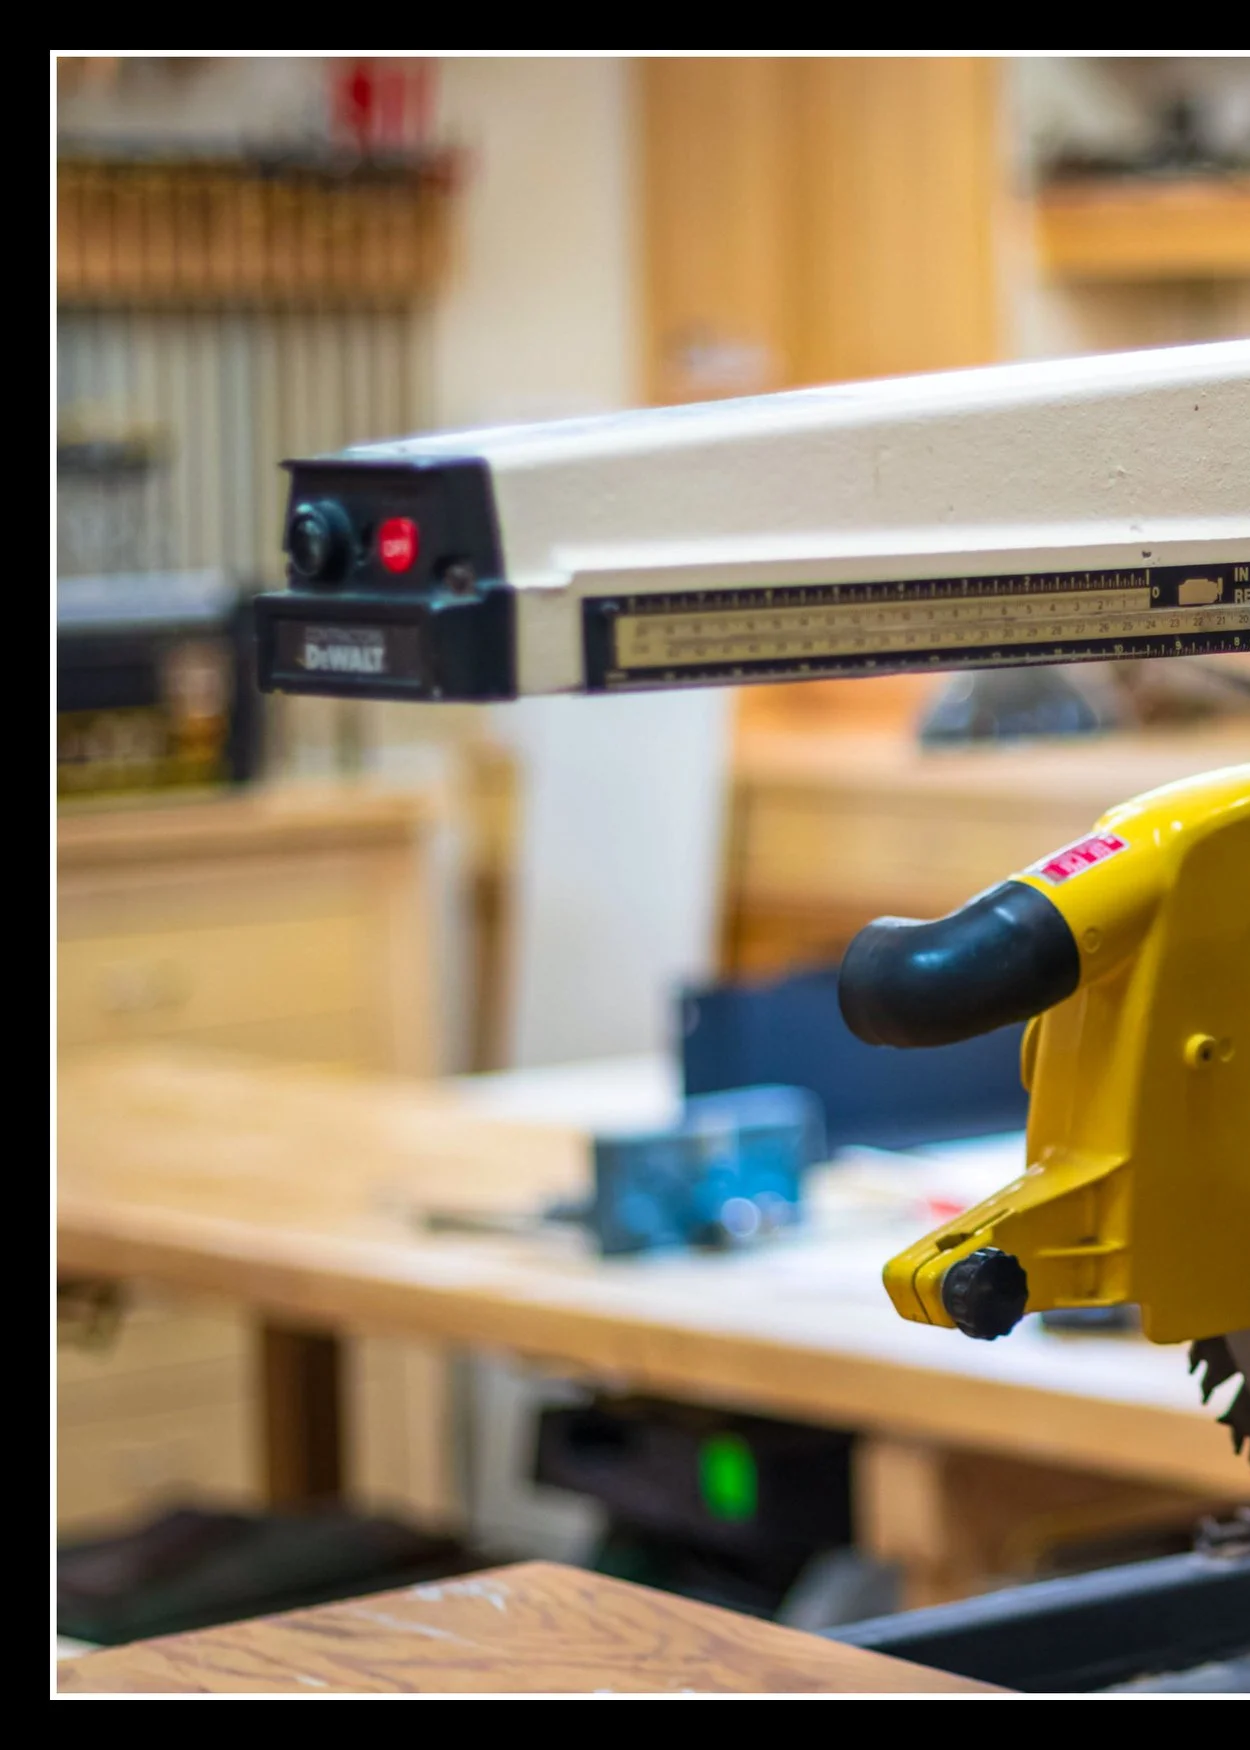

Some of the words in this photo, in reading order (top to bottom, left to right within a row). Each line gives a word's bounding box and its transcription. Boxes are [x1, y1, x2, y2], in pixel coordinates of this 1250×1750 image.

[1234, 567, 1249, 582] IN
[1051, 626, 1062, 636] 28
[1075, 624, 1086, 634] 27
[1098, 623, 1109, 633] 26
[1122, 622, 1134, 631] 25
[1146, 620, 1156, 629] 24
[1169, 618, 1179, 628] 23
[1193, 617, 1203, 627] 22
[1216, 616, 1226, 625] 21
[1238, 615, 1249, 624] 20
[1176, 641, 1182, 650] 9
[1234, 637, 1240, 646] 8
